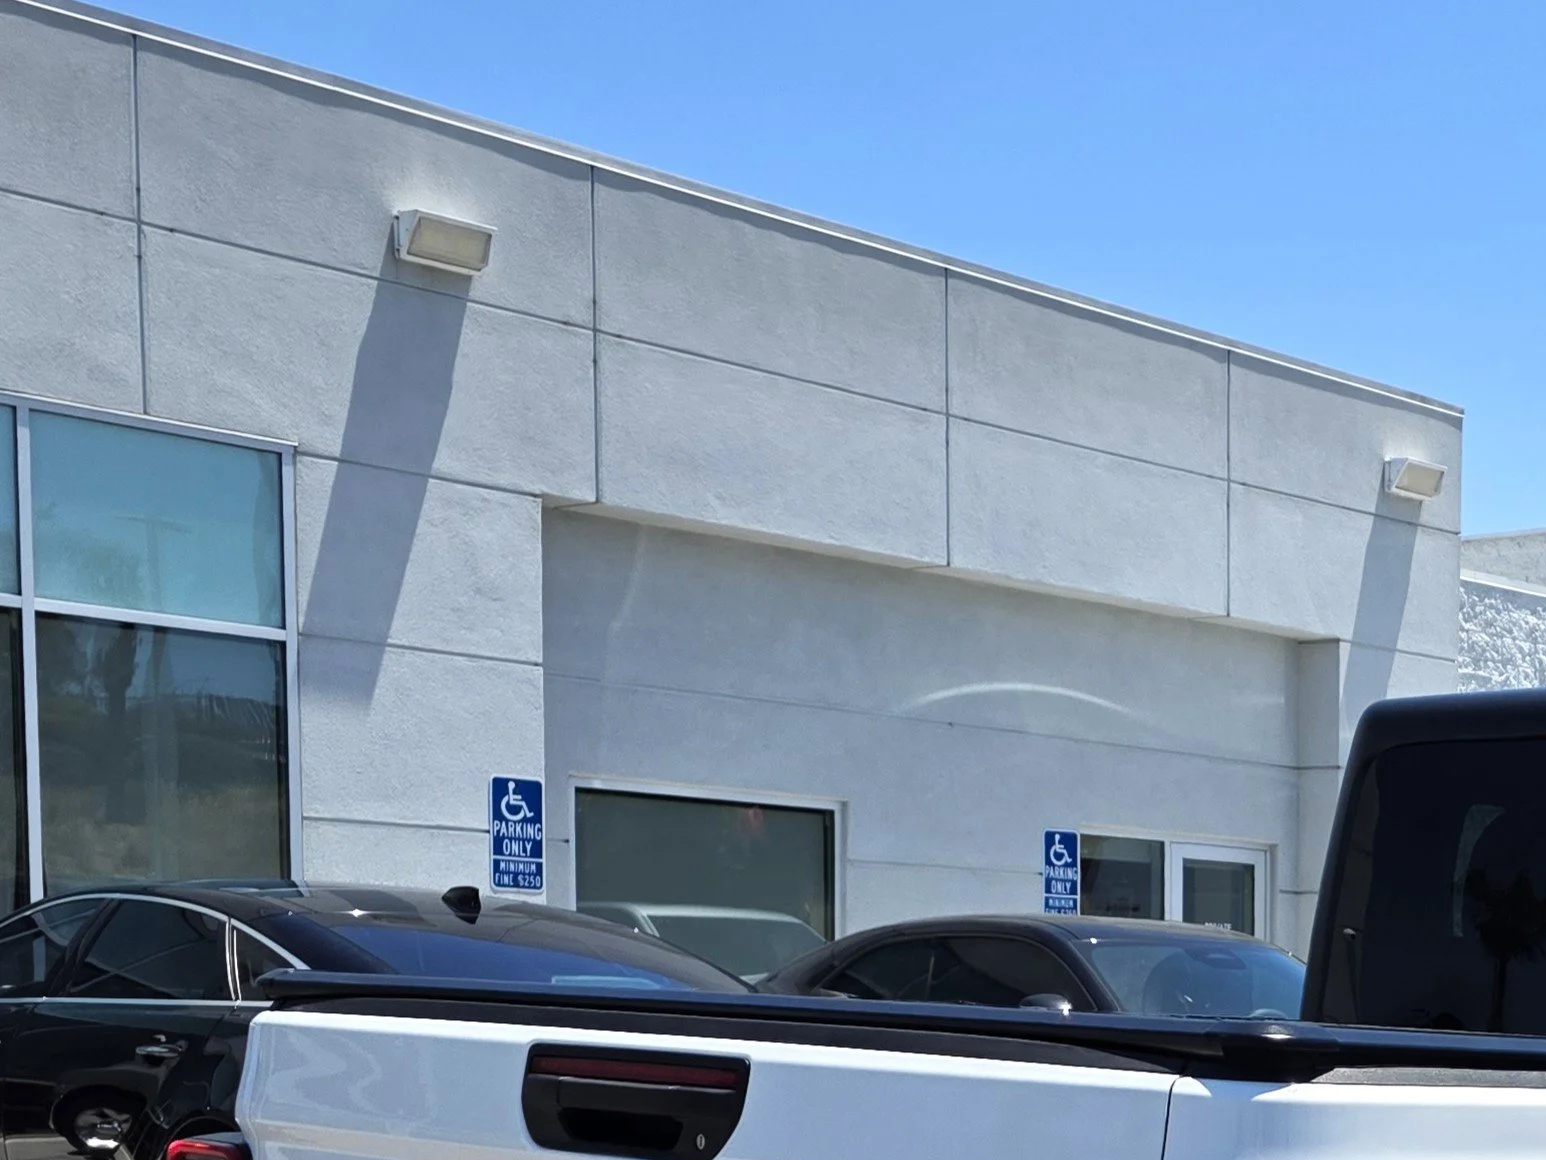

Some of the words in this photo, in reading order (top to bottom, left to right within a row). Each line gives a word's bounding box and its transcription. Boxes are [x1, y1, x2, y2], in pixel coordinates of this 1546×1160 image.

[493, 821, 541, 840] PARKING
[502, 839, 532, 856] ONLY
[499, 861, 536, 873] MINIMUM
[1045, 865, 1078, 880] PARKING
[495, 873, 513, 886] FINE
[517, 874, 541, 887] $250
[1050, 880, 1072, 893] ONLY
